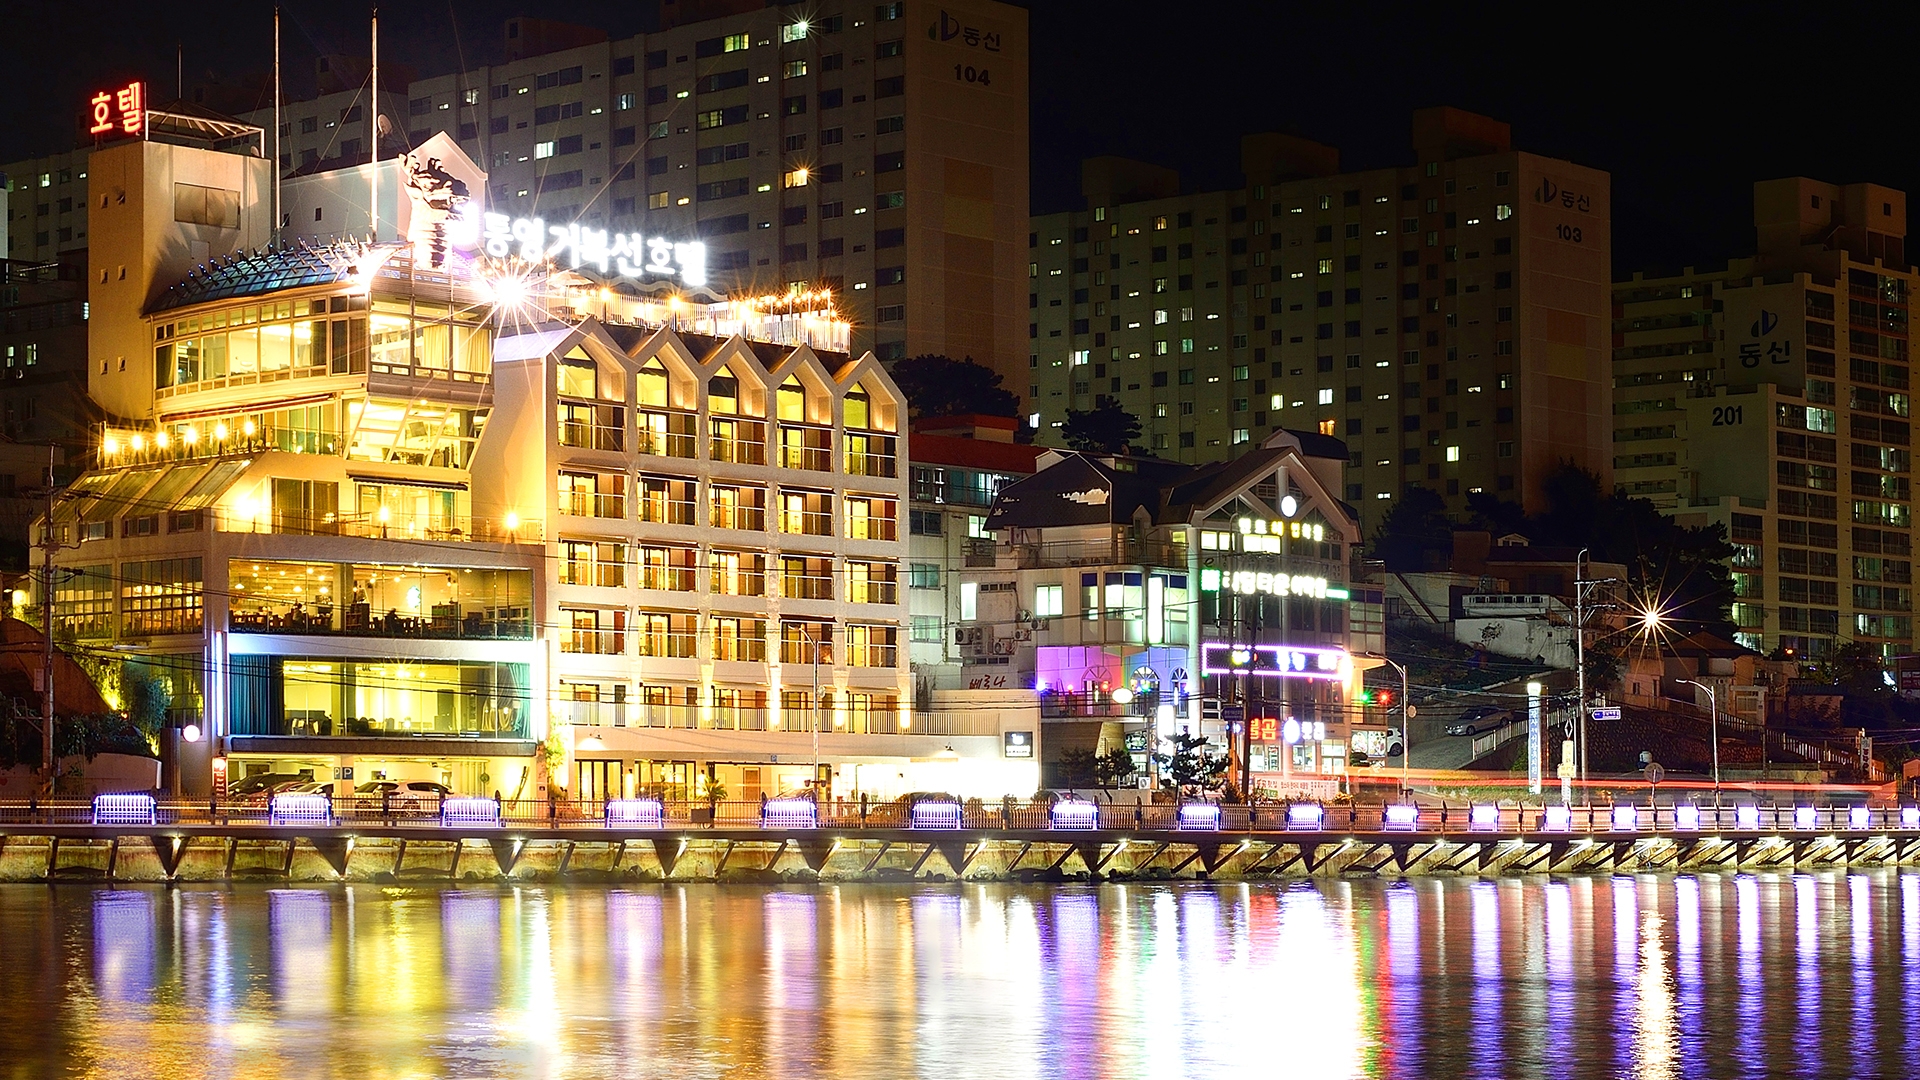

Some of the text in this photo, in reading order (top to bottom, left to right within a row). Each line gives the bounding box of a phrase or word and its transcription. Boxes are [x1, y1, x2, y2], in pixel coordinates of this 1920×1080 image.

[963, 27, 1000, 52] 동신
[954, 64, 991, 86] 104
[91, 82, 141, 133] 호텔
[1561, 190, 1590, 212] 동신
[1556, 224, 1582, 243] 103
[1739, 341, 1790, 368] 동신
[1712, 405, 1743, 426] 201
